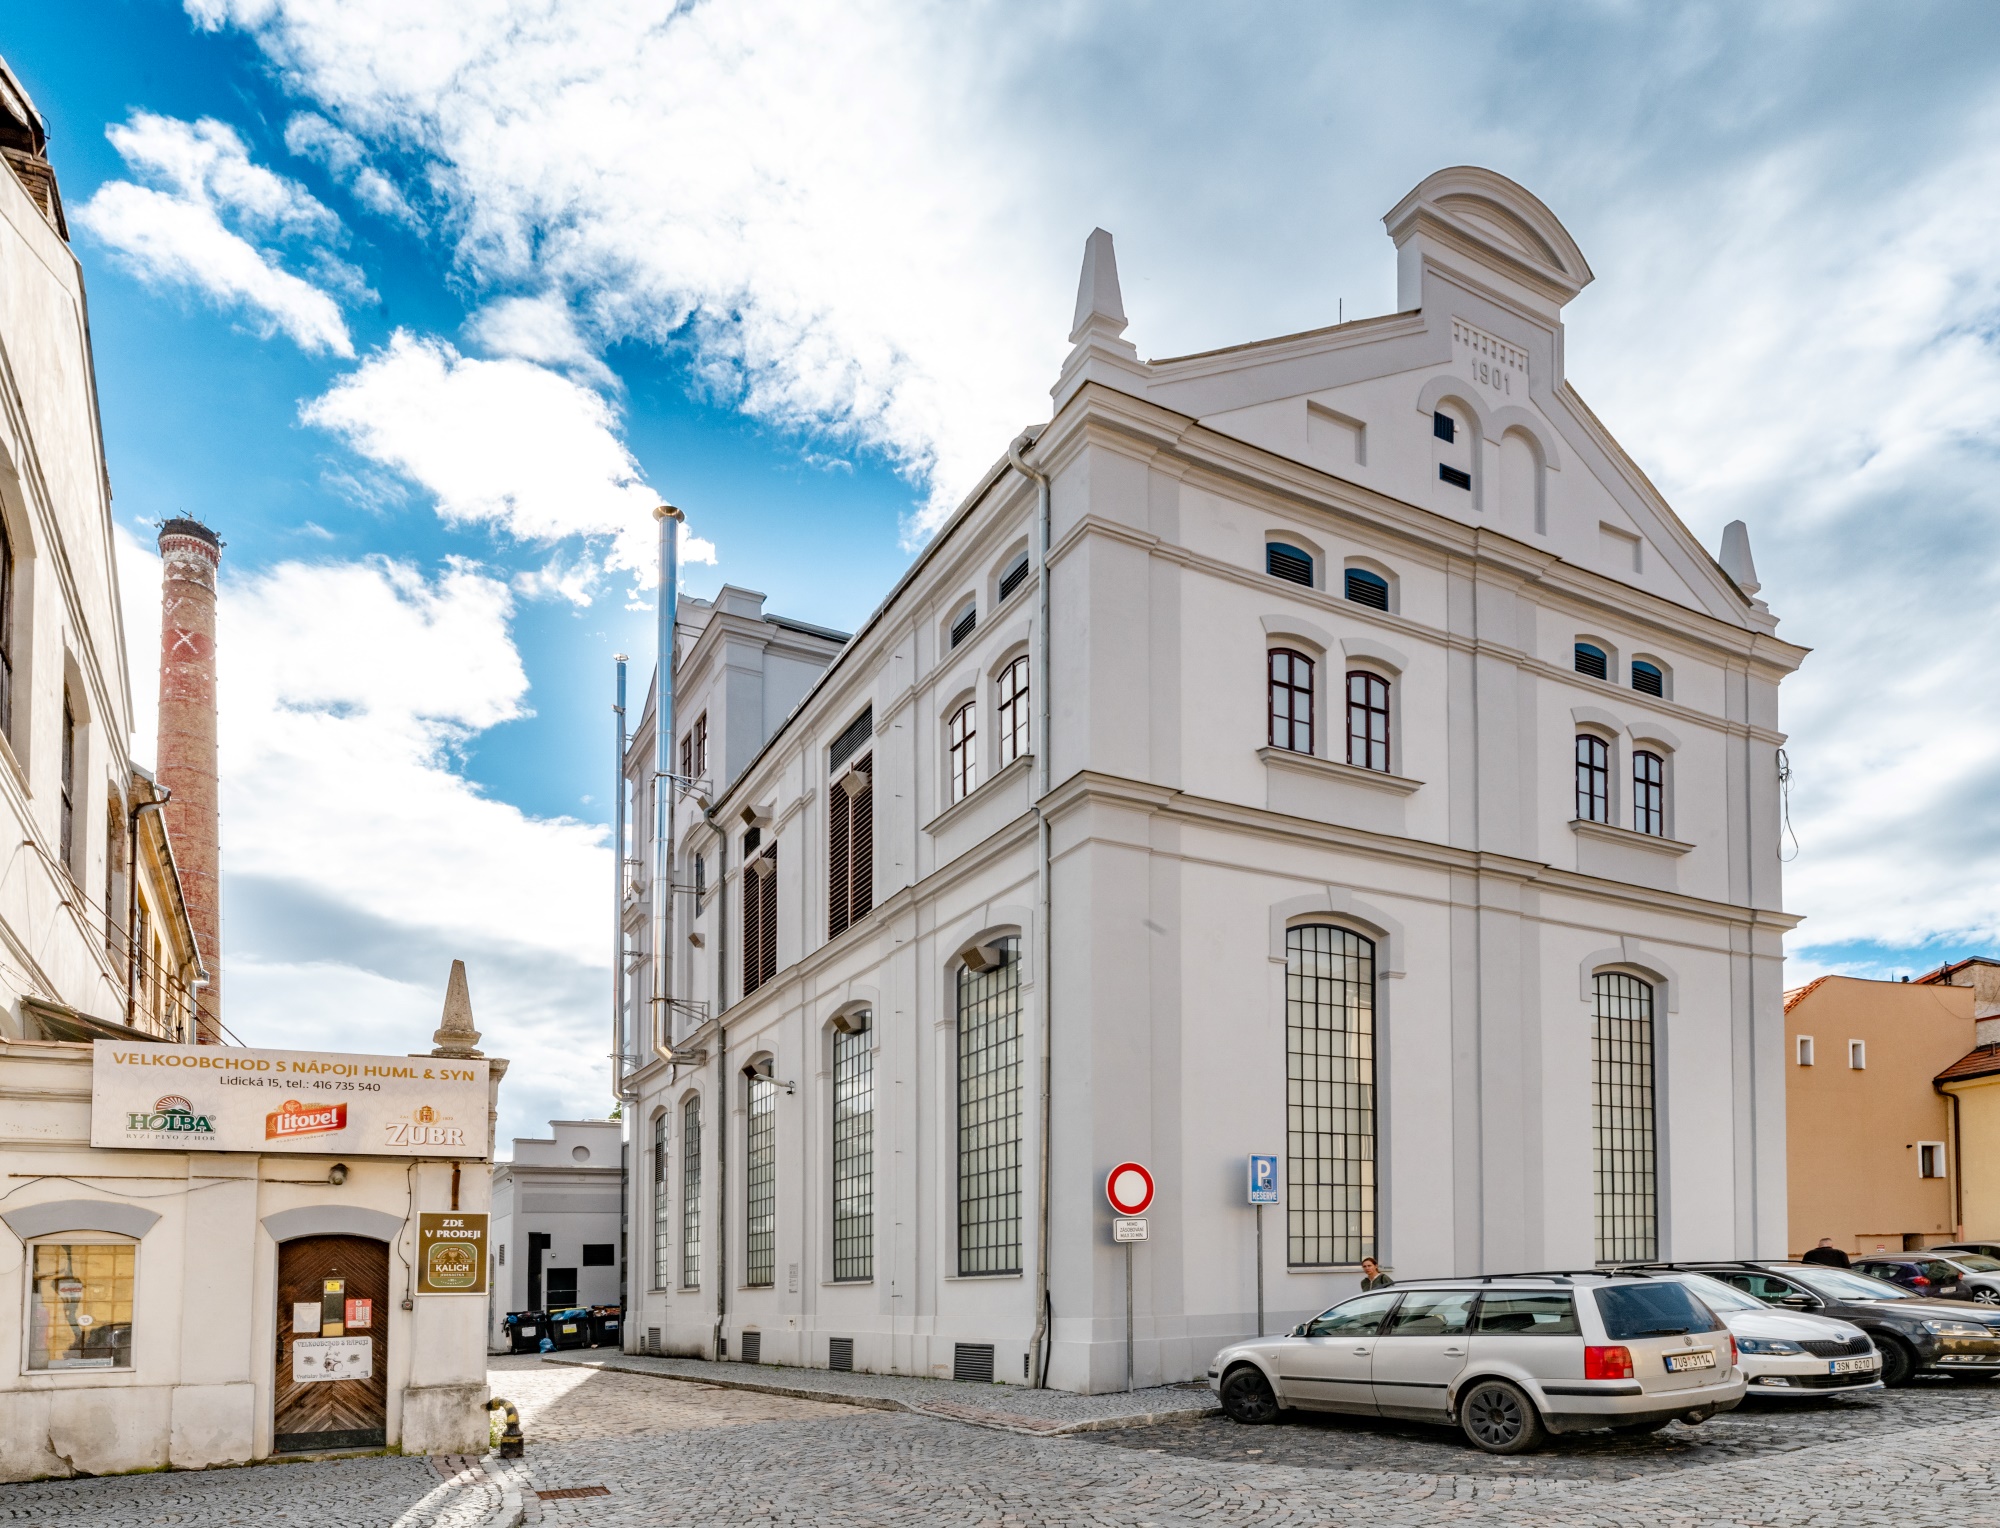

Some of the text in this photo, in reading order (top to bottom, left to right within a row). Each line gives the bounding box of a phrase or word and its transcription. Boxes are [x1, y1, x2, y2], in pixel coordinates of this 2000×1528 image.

[1471, 357, 1510, 396] 1901
[112, 1052, 475, 1082] VELKOOBCHOD S NÁPOJI HUML & SYN
[219, 1076, 381, 1092] Lidická 15, tel.: 416 735 540
[126, 1113, 214, 1133] HOLBA
[276, 1108, 339, 1134] Litovel
[385, 1122, 466, 1146] ZUBR
[1257, 1159, 1271, 1187] P
[1252, 1189, 1277, 1201] RÉSERVÉ
[442, 1219, 465, 1227] ZDE
[424, 1229, 481, 1240] V PRODEJI
[435, 1264, 469, 1273] KALICH
[1672, 1356, 1688, 1369] 7U9
[1691, 1354, 1711, 1366] 3114
[1836, 1359, 1870, 1371] 3SN 6210
